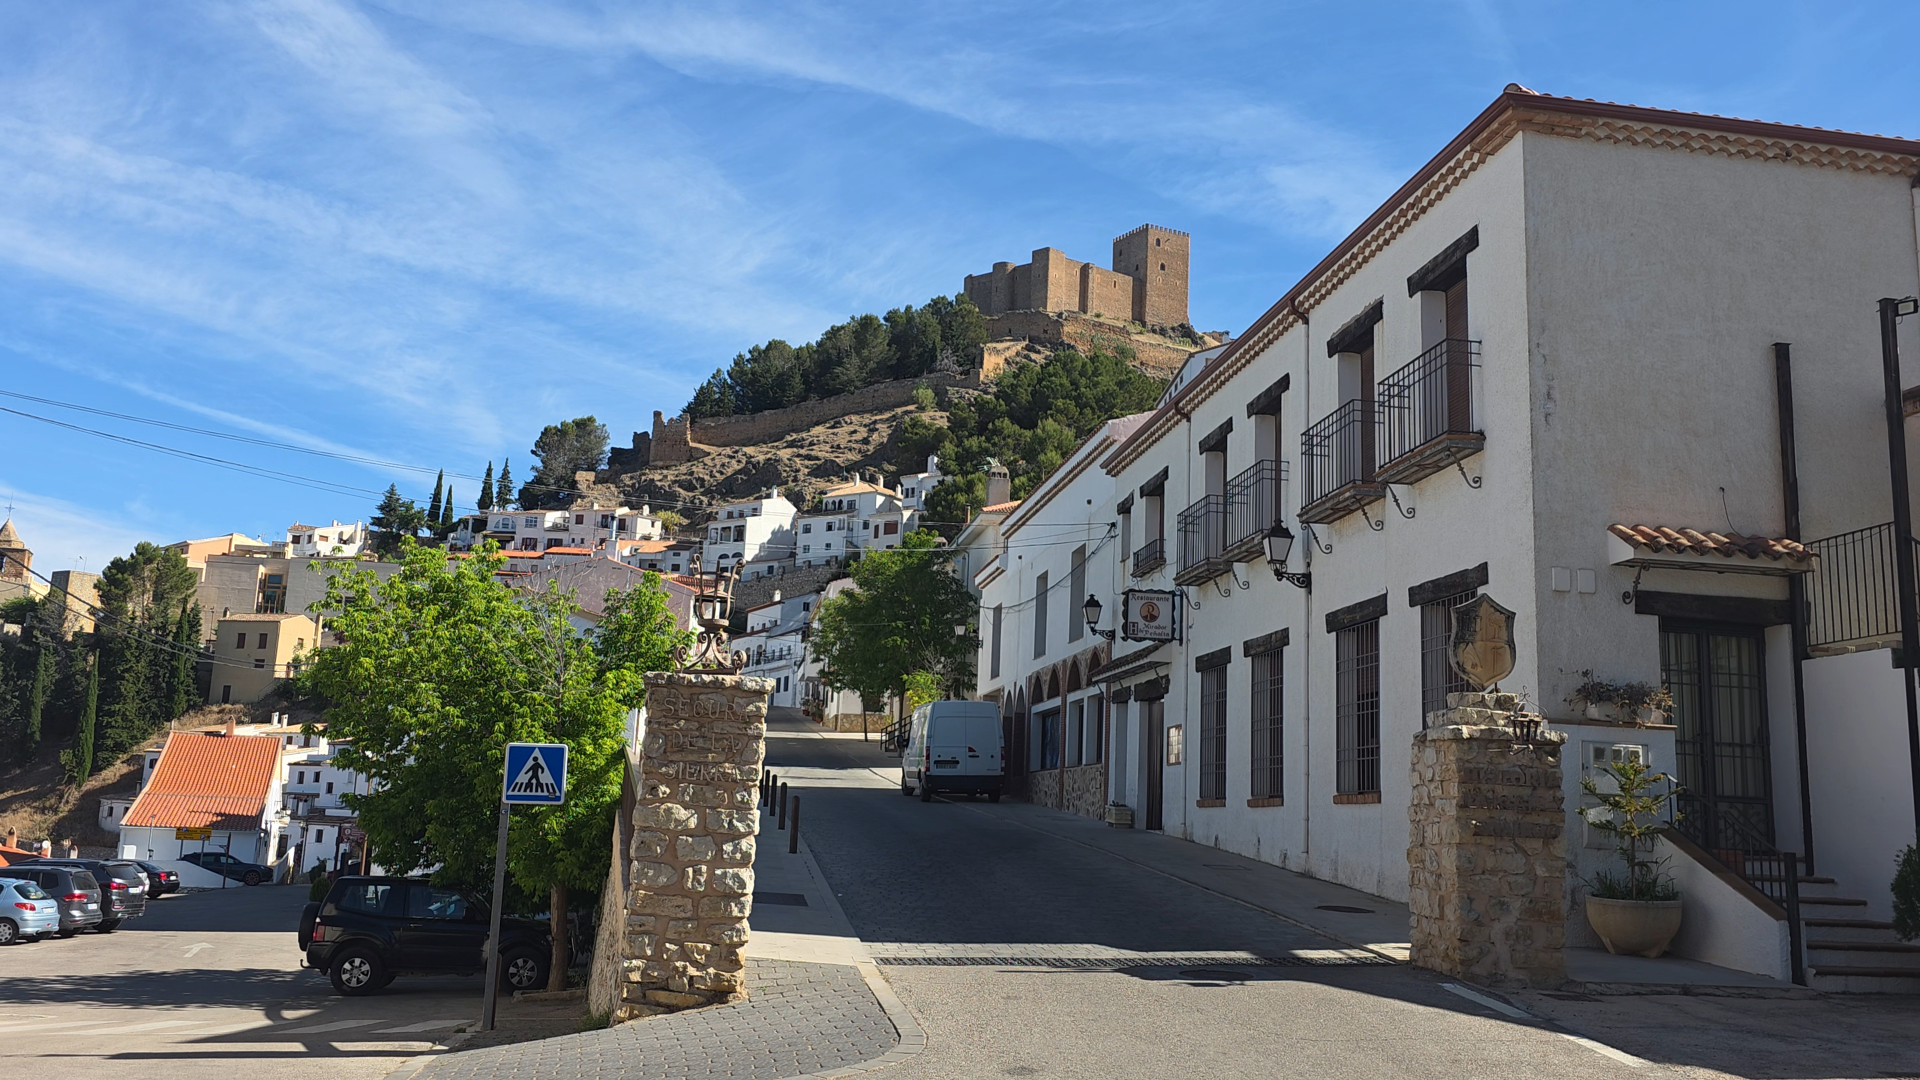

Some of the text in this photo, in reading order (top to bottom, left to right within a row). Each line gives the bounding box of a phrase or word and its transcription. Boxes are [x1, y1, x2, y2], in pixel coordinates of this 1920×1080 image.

[1130, 594, 1170, 602] Restaurante
[663, 697, 749, 721] SEGURA
[672, 731, 699, 750] DE
[664, 762, 741, 782] SIERRA
